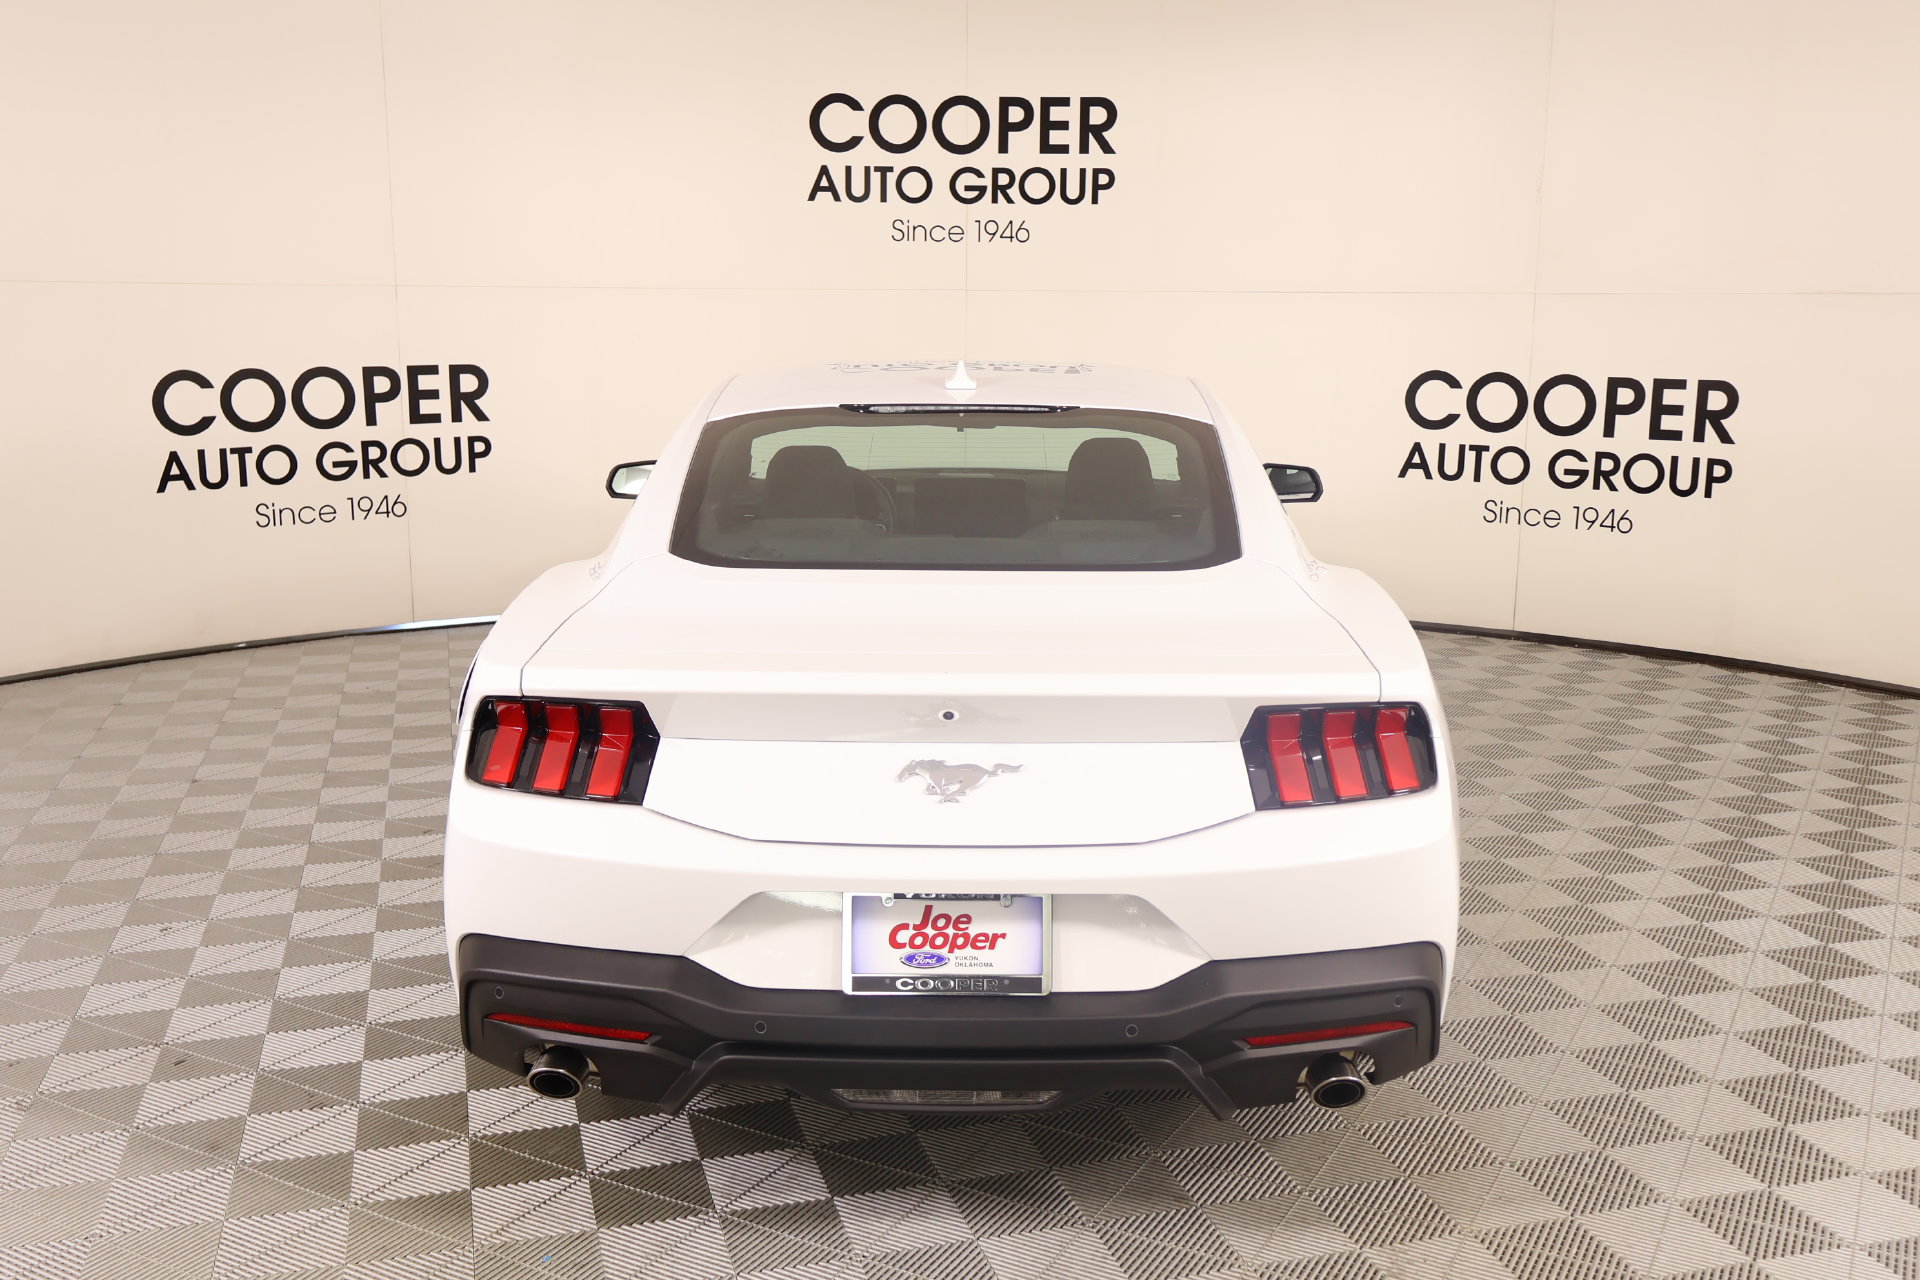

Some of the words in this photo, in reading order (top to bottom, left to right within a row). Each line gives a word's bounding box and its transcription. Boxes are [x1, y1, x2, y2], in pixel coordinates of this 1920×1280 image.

[809, 93, 1118, 155] COOPER
[807, 165, 933, 204] AUTO
[949, 167, 1116, 205] GROUP
[891, 219, 965, 242] Since
[974, 220, 1030, 243] 1946
[152, 364, 491, 436] COOPER
[1405, 370, 1739, 444] COOPER
[156, 444, 298, 493] AUTO
[316, 435, 492, 481] GROUP
[1398, 442, 1530, 485] AUTO
[1548, 449, 1732, 499] GROUP
[256, 503, 337, 528] Since
[347, 494, 408, 520] 1946
[1483, 500, 1561, 528] Since
[1573, 506, 1634, 534] 1946
[912, 905, 973, 931] Joe
[889, 923, 1007, 954] Cooper
[913, 954, 938, 965] Ford
[895, 978, 999, 991] COOPER
